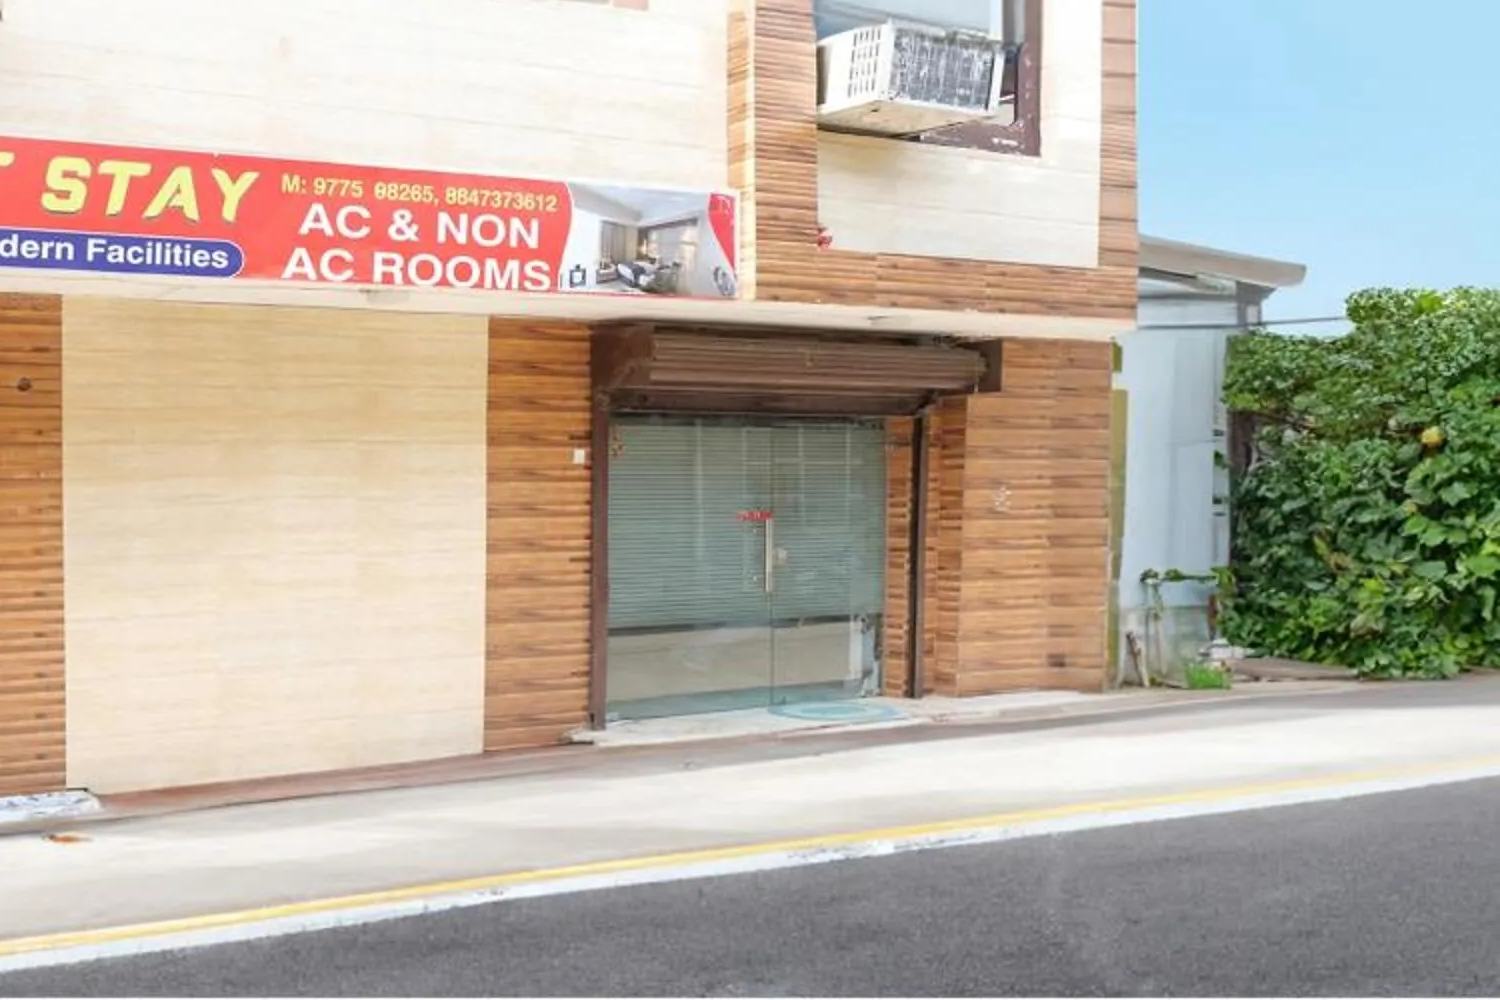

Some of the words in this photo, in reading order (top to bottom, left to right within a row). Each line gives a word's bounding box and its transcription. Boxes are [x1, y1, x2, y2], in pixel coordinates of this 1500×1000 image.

[41, 156, 259, 223] STAY
[281, 173, 307, 194] M:
[313, 177, 364, 198] 9775
[299, 203, 371, 239] AC
[387, 209, 419, 241] &
[437, 212, 539, 249] NON
[87, 239, 230, 269] Facilities
[281, 248, 355, 281] AC
[373, 252, 551, 290] ROOMS
